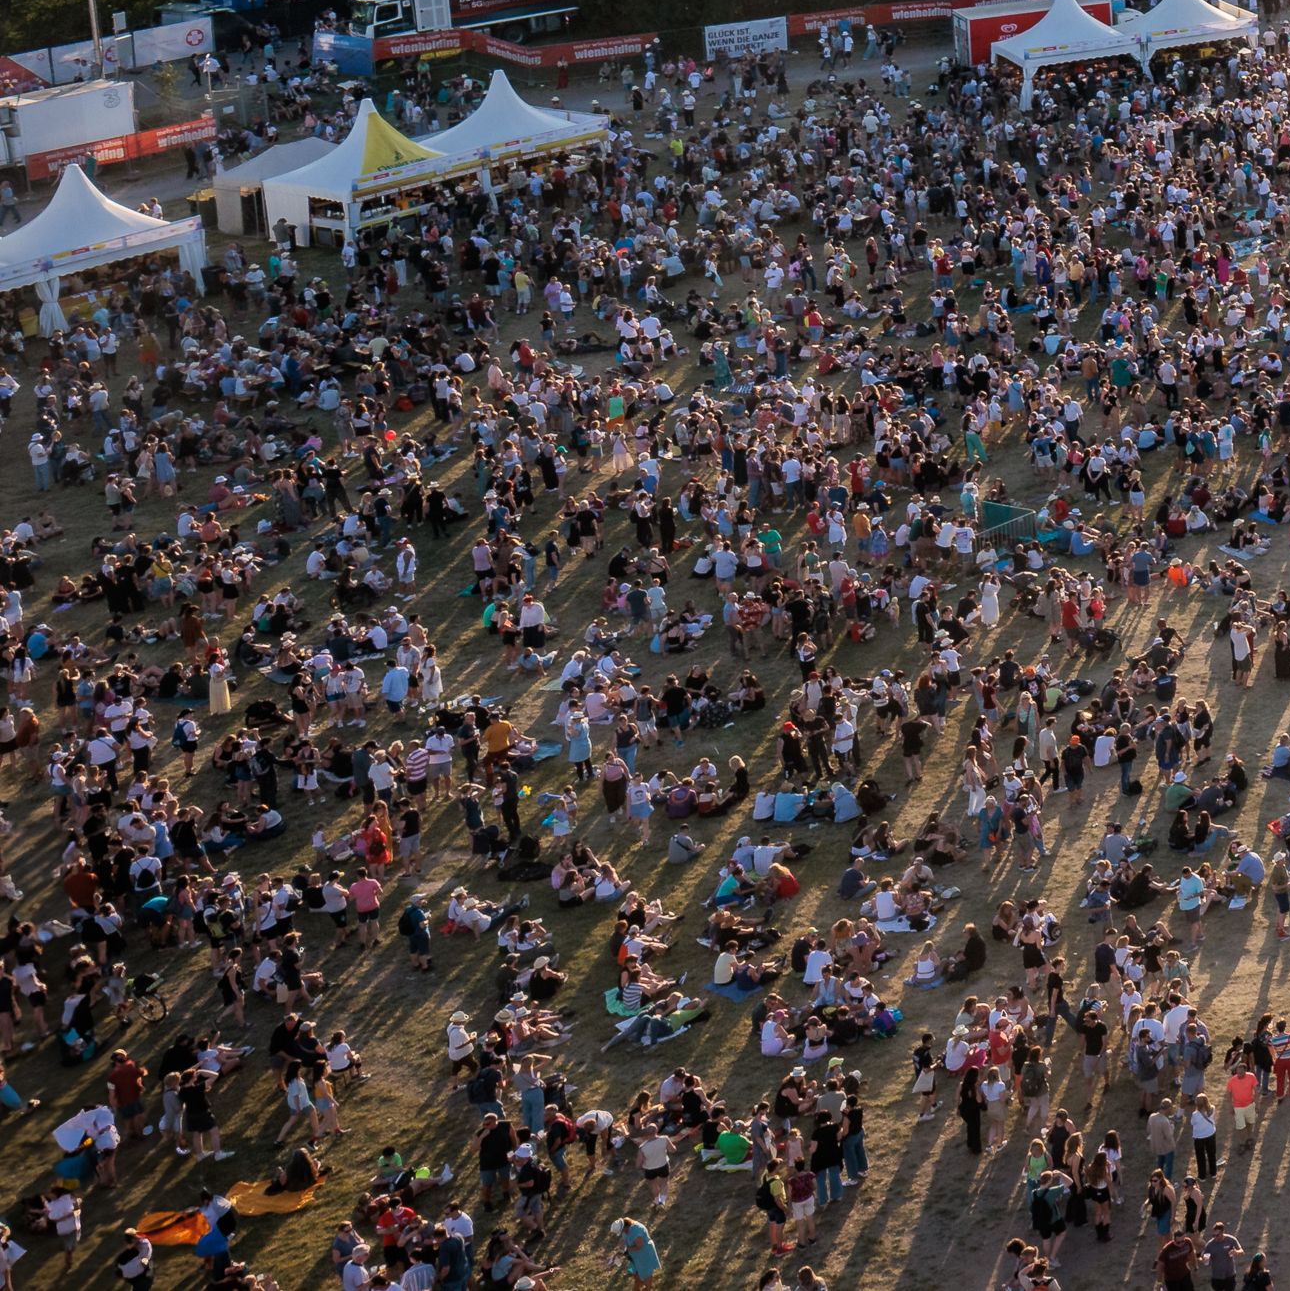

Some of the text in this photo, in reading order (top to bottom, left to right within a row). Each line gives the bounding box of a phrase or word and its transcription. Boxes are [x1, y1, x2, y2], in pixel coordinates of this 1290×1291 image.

[892, 7, 952, 20] wienholding
[707, 29, 735, 40] GLÜCK
[707, 31, 780, 47] WENN DIE GANZE
[390, 37, 460, 55] wienholding
[486, 44, 542, 66] wienholding
[575, 42, 642, 60] wienholding
[103, 89, 121, 109] 3
